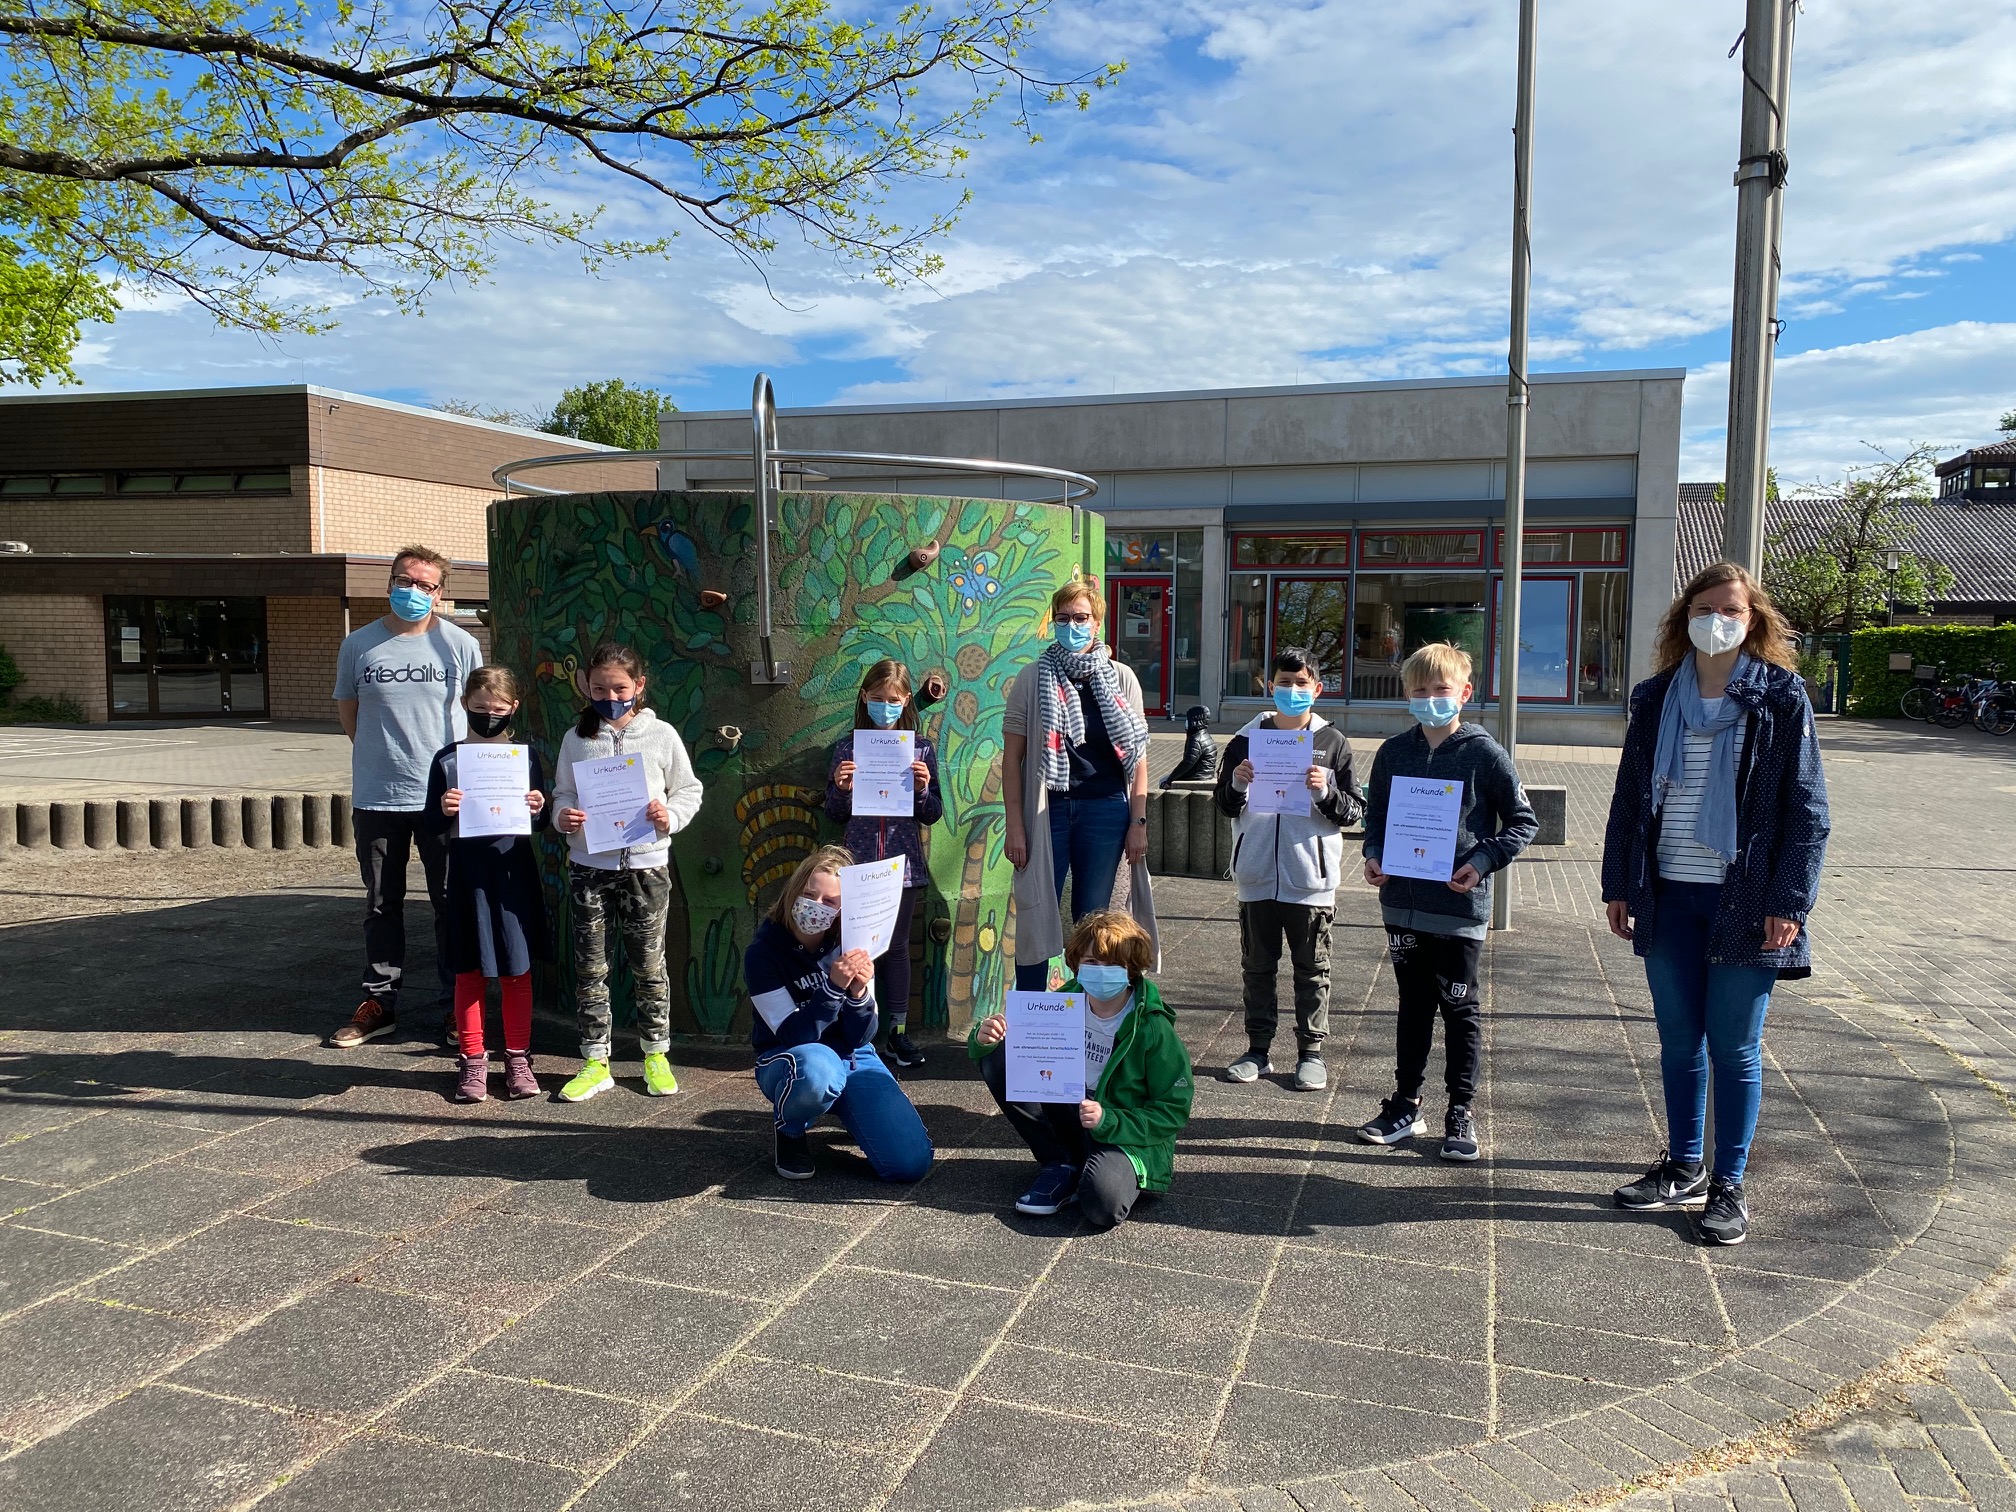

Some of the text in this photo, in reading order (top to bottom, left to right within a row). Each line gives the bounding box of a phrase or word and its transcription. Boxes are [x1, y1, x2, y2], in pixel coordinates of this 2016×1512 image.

[870, 737, 900, 745] Urkunde
[1266, 737, 1297, 746] Urkunde
[477, 751, 511, 760] Urkunde
[593, 763, 627, 775] Urkunde
[1410, 785, 1445, 797] Urkunde
[861, 869, 892, 882] Urkunde
[1453, 984, 1466, 996] 62
[1027, 1002, 1065, 1012] Urkunde
